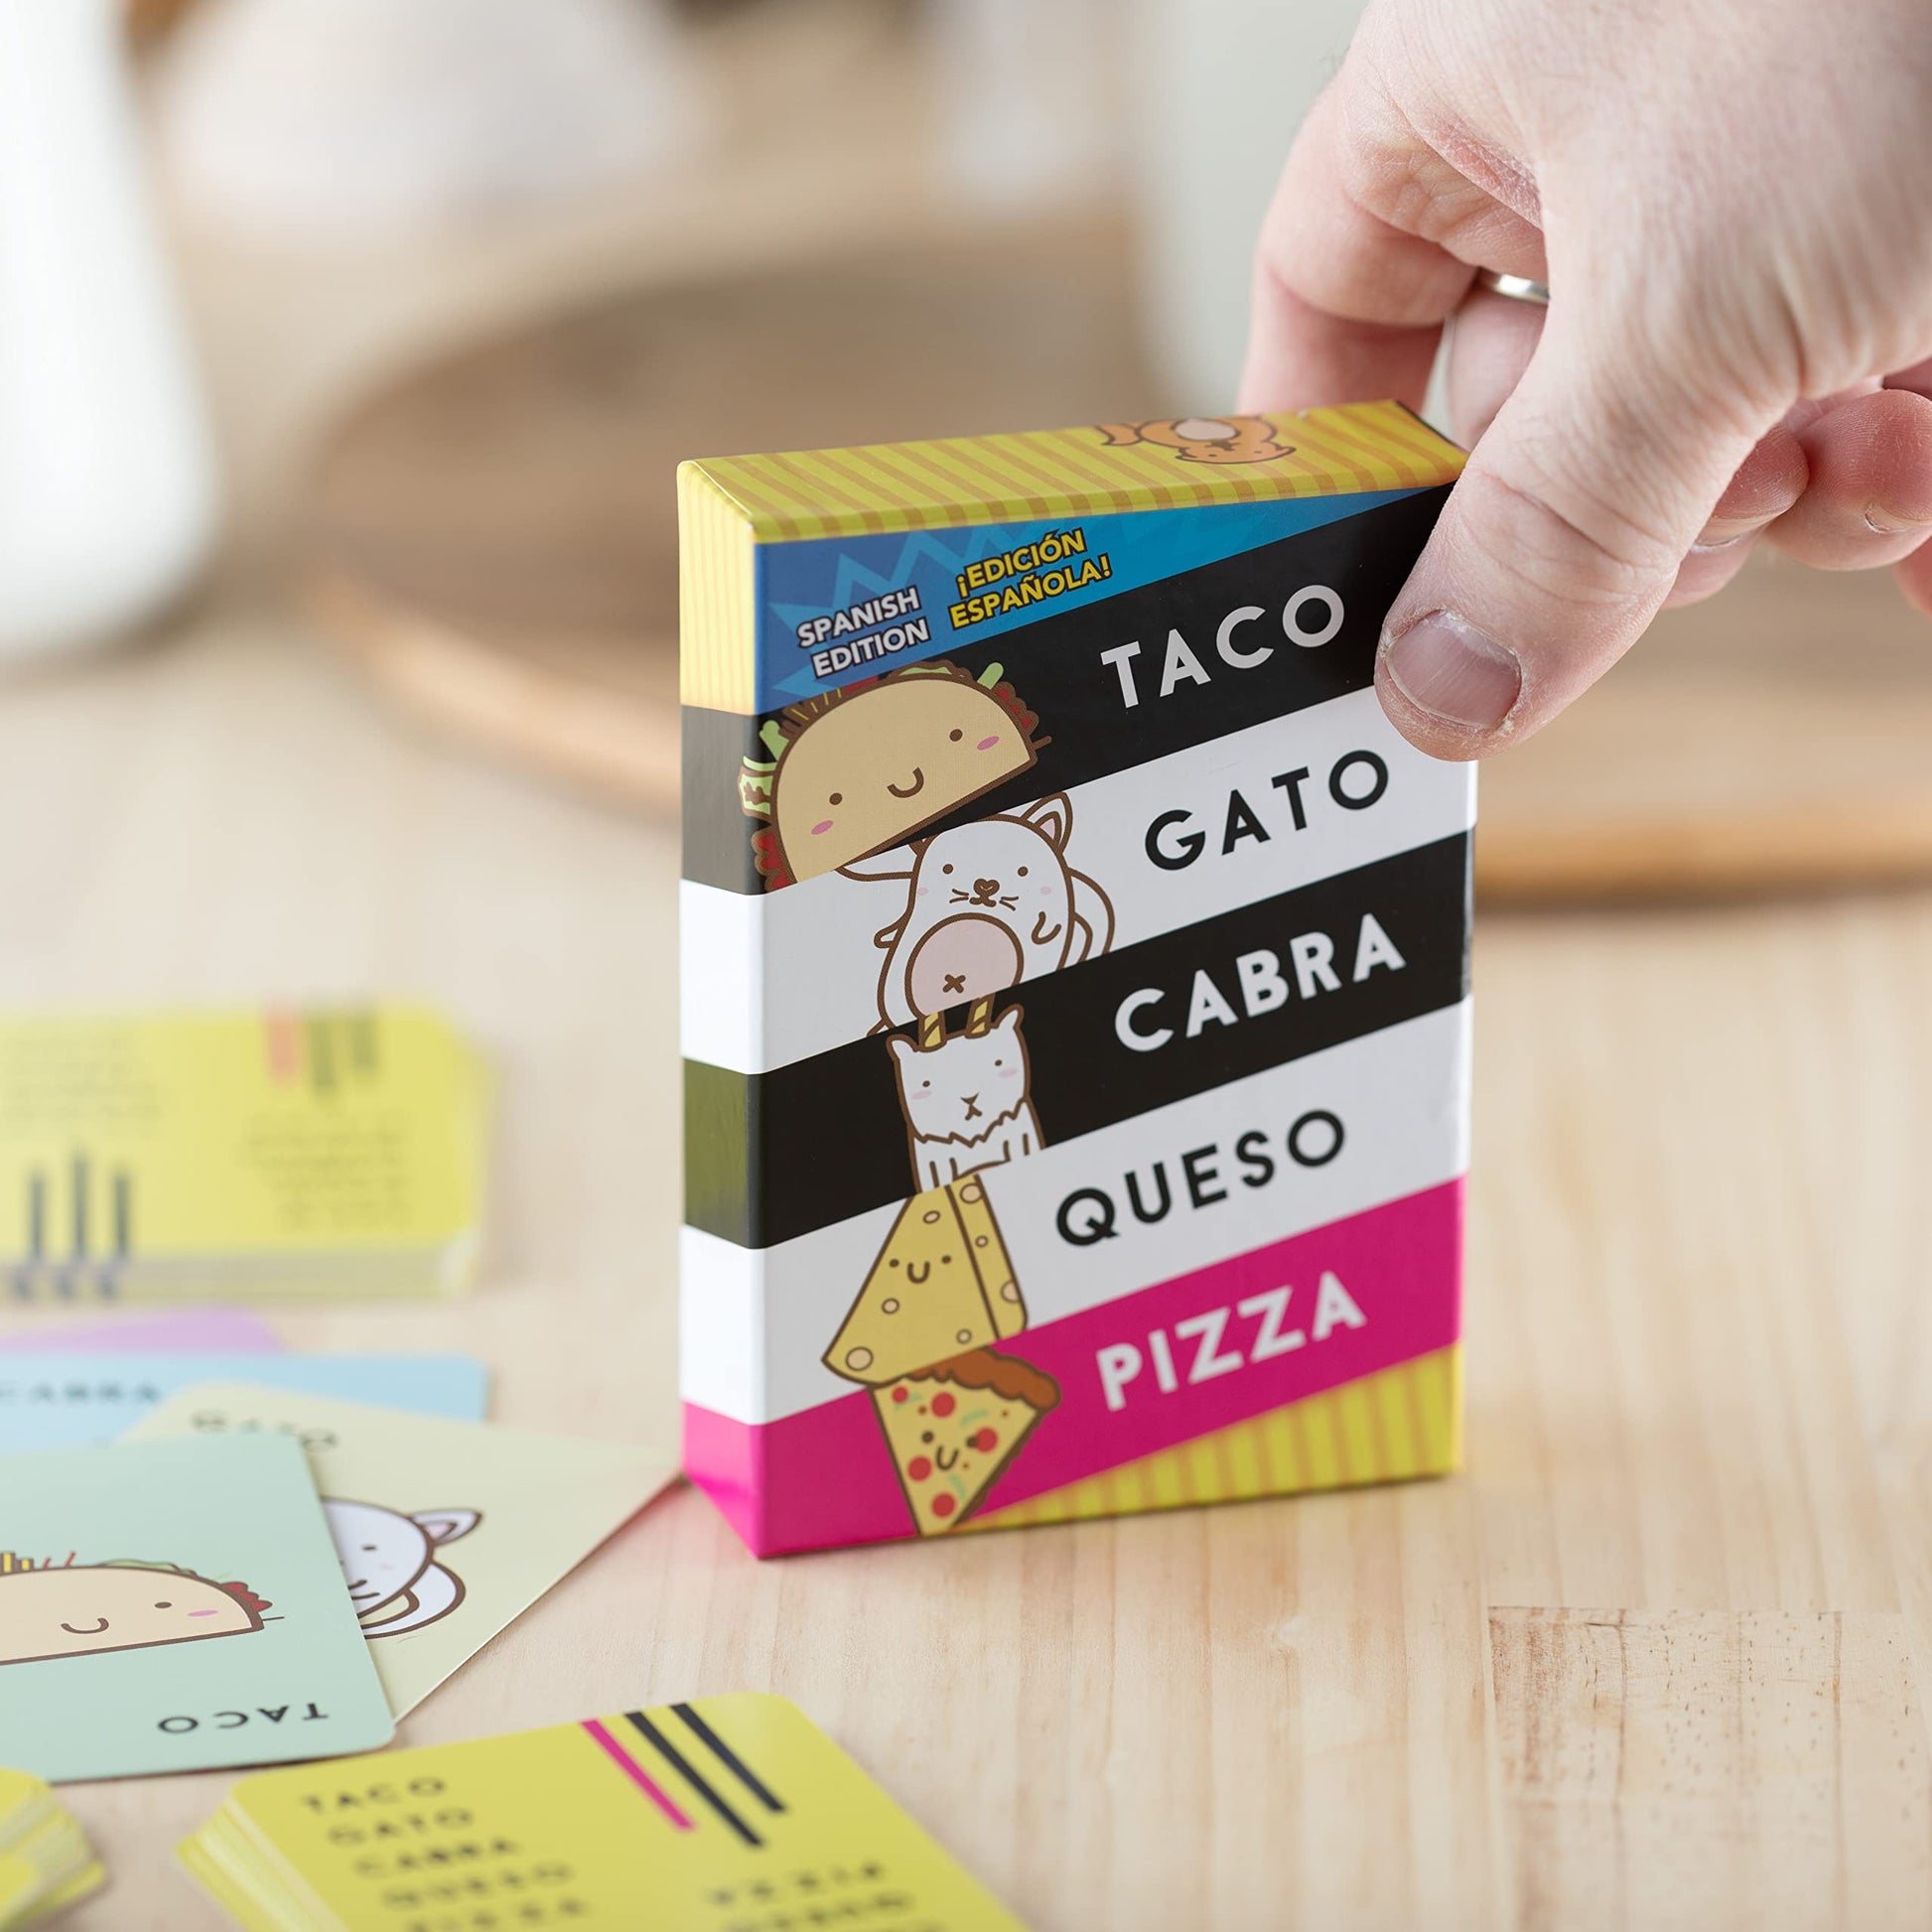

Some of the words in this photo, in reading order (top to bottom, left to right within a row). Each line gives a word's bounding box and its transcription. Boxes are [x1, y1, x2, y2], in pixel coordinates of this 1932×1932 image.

[948, 553, 1113, 630] ESPAÑOLA!
[956, 527, 1086, 598] ¡EDICIÓN
[797, 585, 921, 648] SPANISH
[811, 619, 931, 678] EDITION
[1100, 584, 1344, 708] TACO
[1145, 750, 1389, 871] GATO
[1115, 912, 1406, 1051] CABRA
[1056, 1110, 1345, 1246] QUESO
[1096, 1270, 1367, 1412] PIZZA
[158, 1702, 331, 1734] TACO
[300, 1775, 447, 1813] TACO
[326, 1806, 476, 1847] GATO
